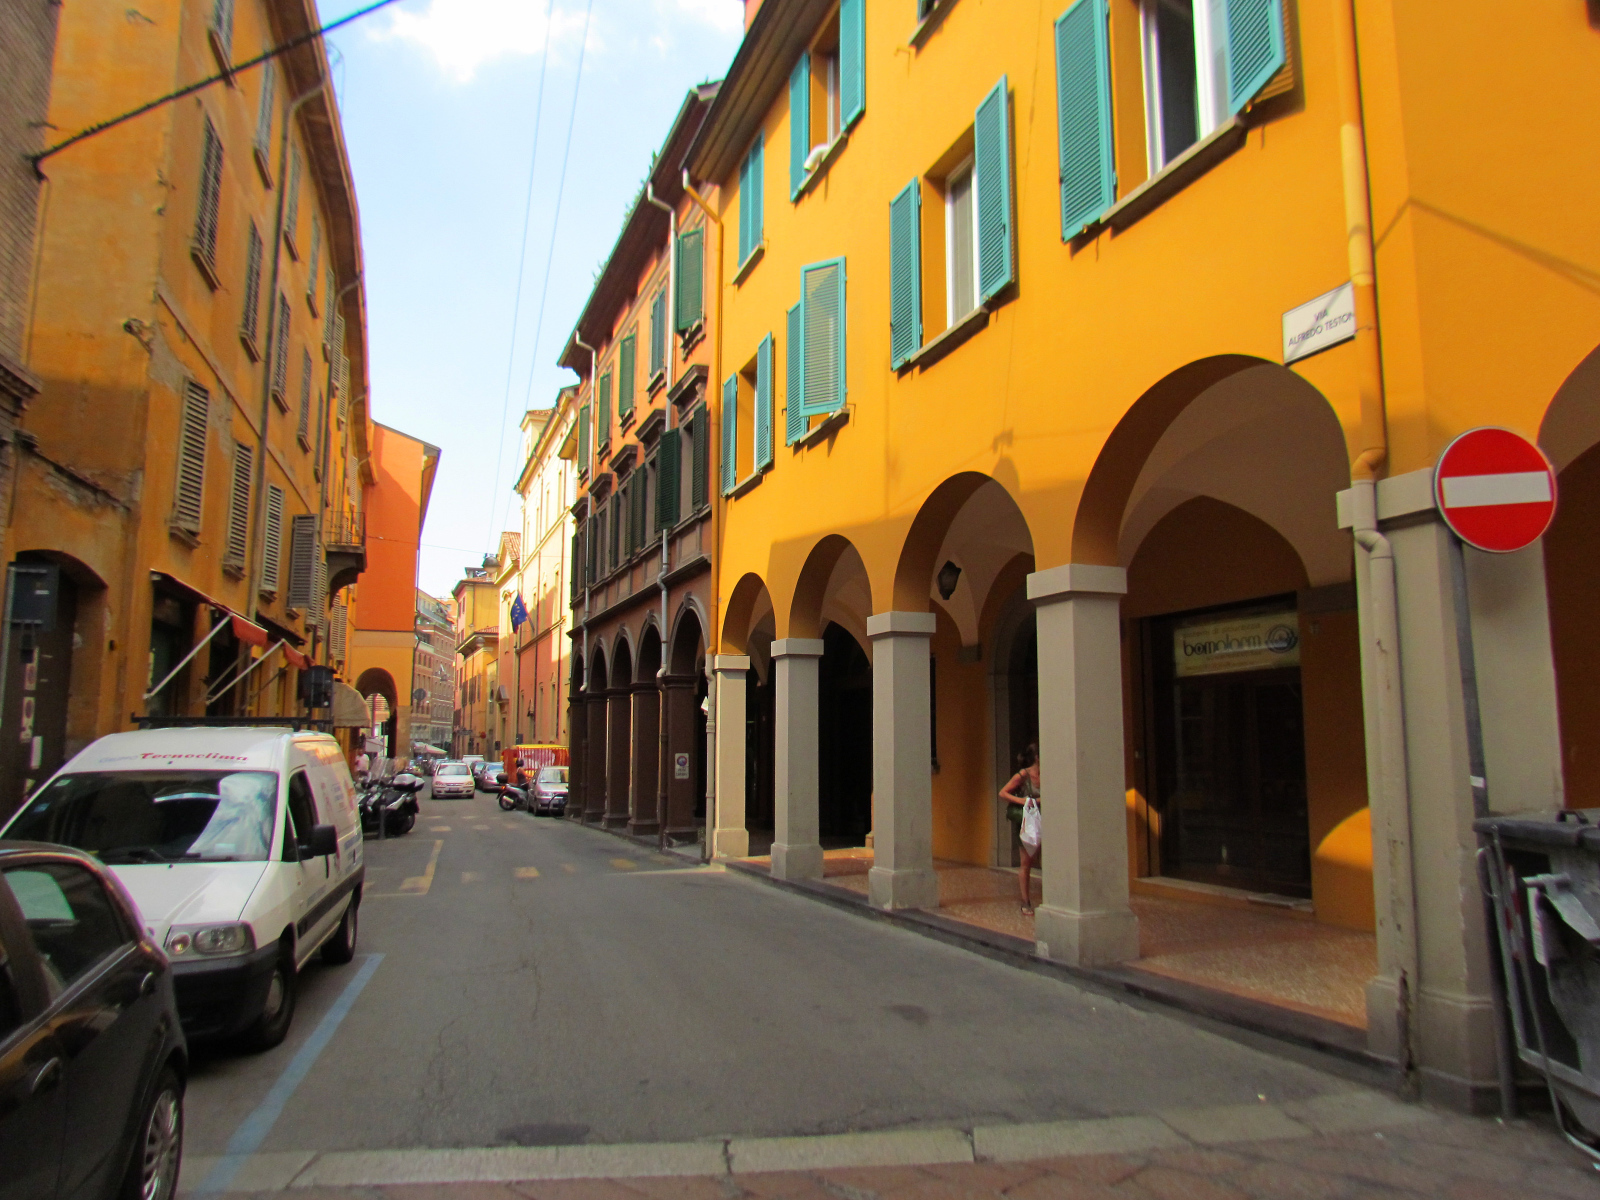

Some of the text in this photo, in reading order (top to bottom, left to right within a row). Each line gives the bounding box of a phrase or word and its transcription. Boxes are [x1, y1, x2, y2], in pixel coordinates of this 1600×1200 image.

[1314, 309, 1328, 322] VIA
[1288, 325, 1323, 346] ALFREDO
[140, 752, 248, 761] Tecnoclima
